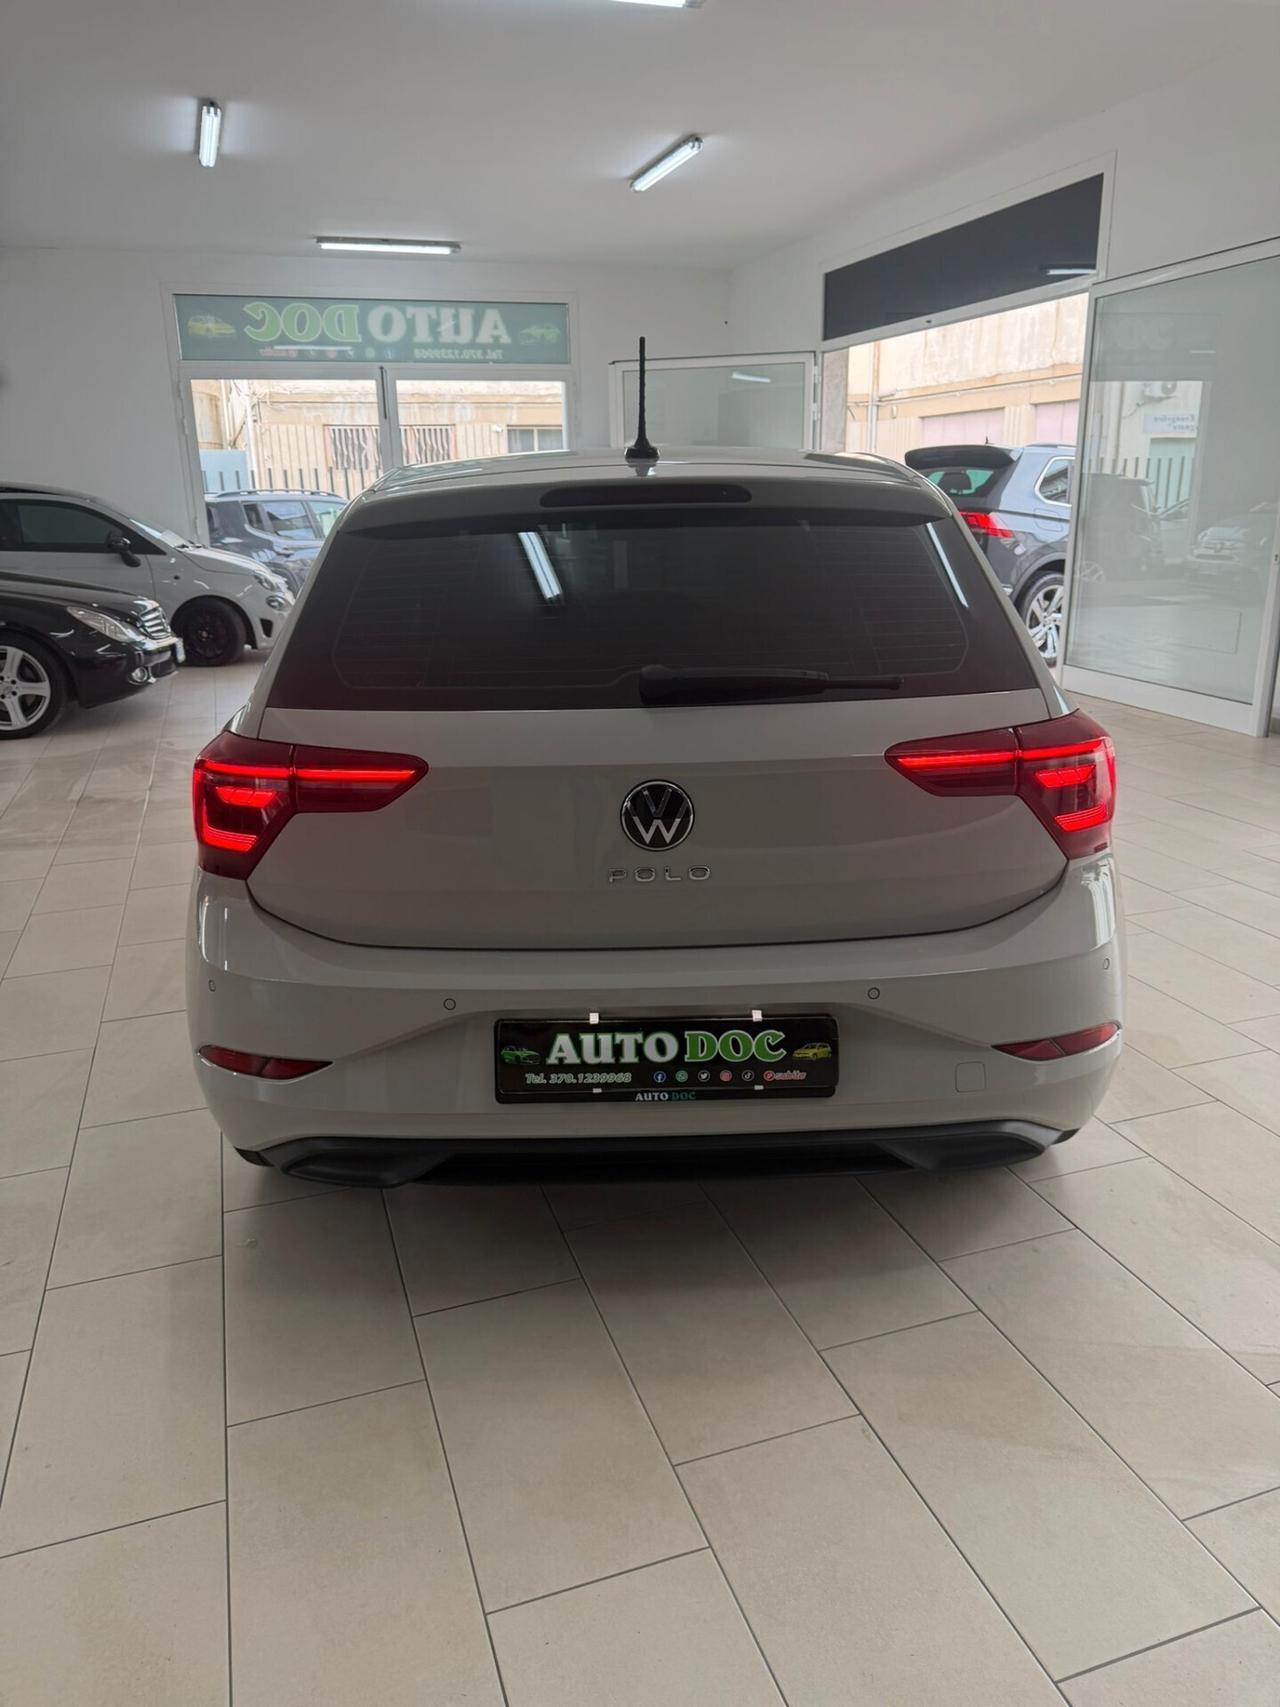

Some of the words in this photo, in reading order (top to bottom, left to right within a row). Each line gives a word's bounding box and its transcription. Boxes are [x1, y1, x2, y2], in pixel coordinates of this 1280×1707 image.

[608, 864, 711, 884] POLO
[545, 1031, 679, 1065] AUTO
[684, 1030, 787, 1063] DOC
[525, 1072, 547, 1084] Tel.
[549, 1072, 632, 1084] 370.1239968
[635, 1092, 669, 1101] AUTO
[671, 1091, 697, 1101] DOC
